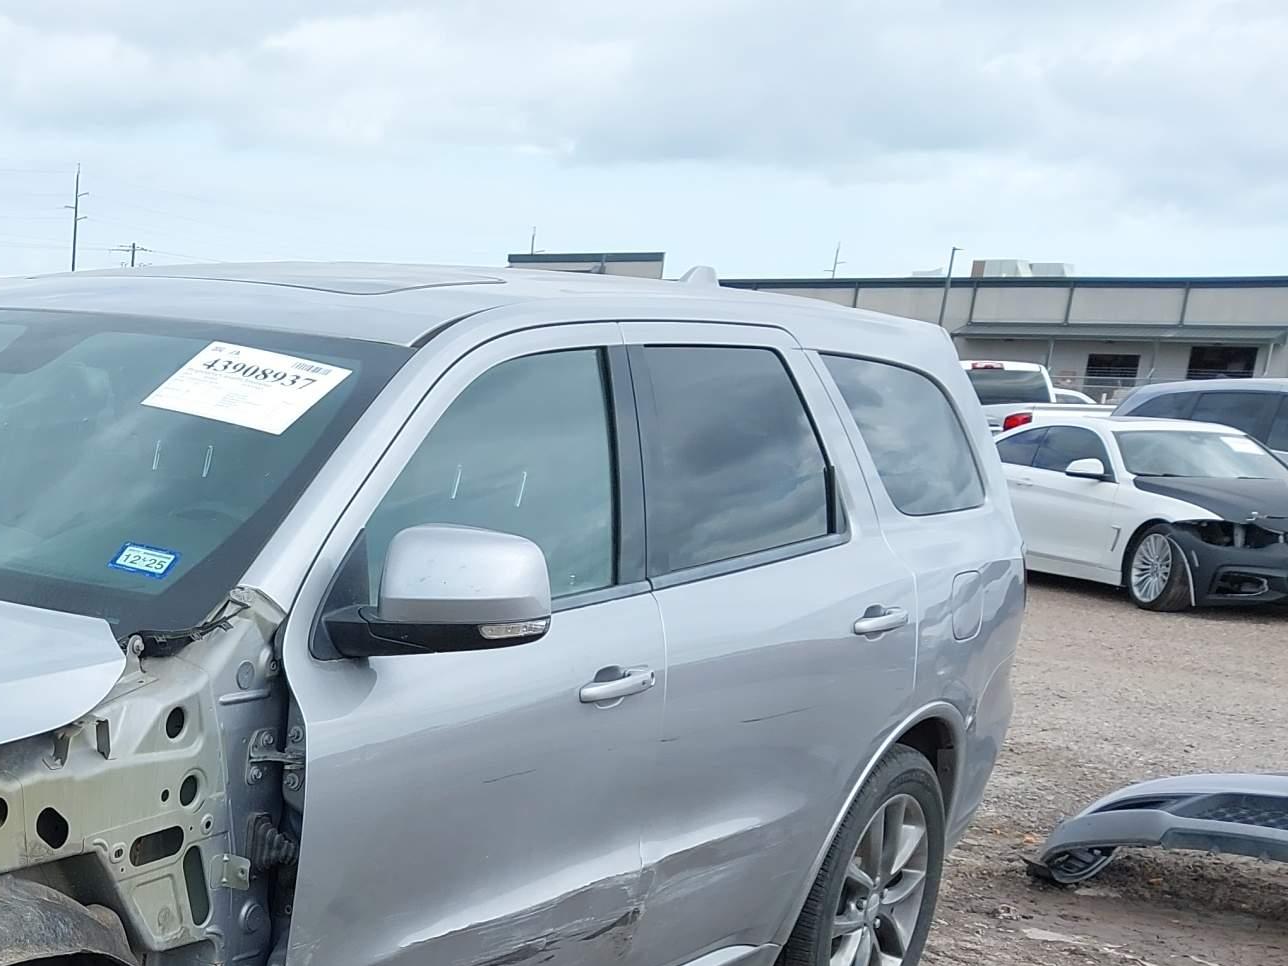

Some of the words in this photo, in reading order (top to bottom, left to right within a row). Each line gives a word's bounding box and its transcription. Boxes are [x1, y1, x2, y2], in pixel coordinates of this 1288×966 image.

[202, 358, 318, 390] 43908937
[123, 553, 142, 565] 12
[145, 558, 167, 570] 25
